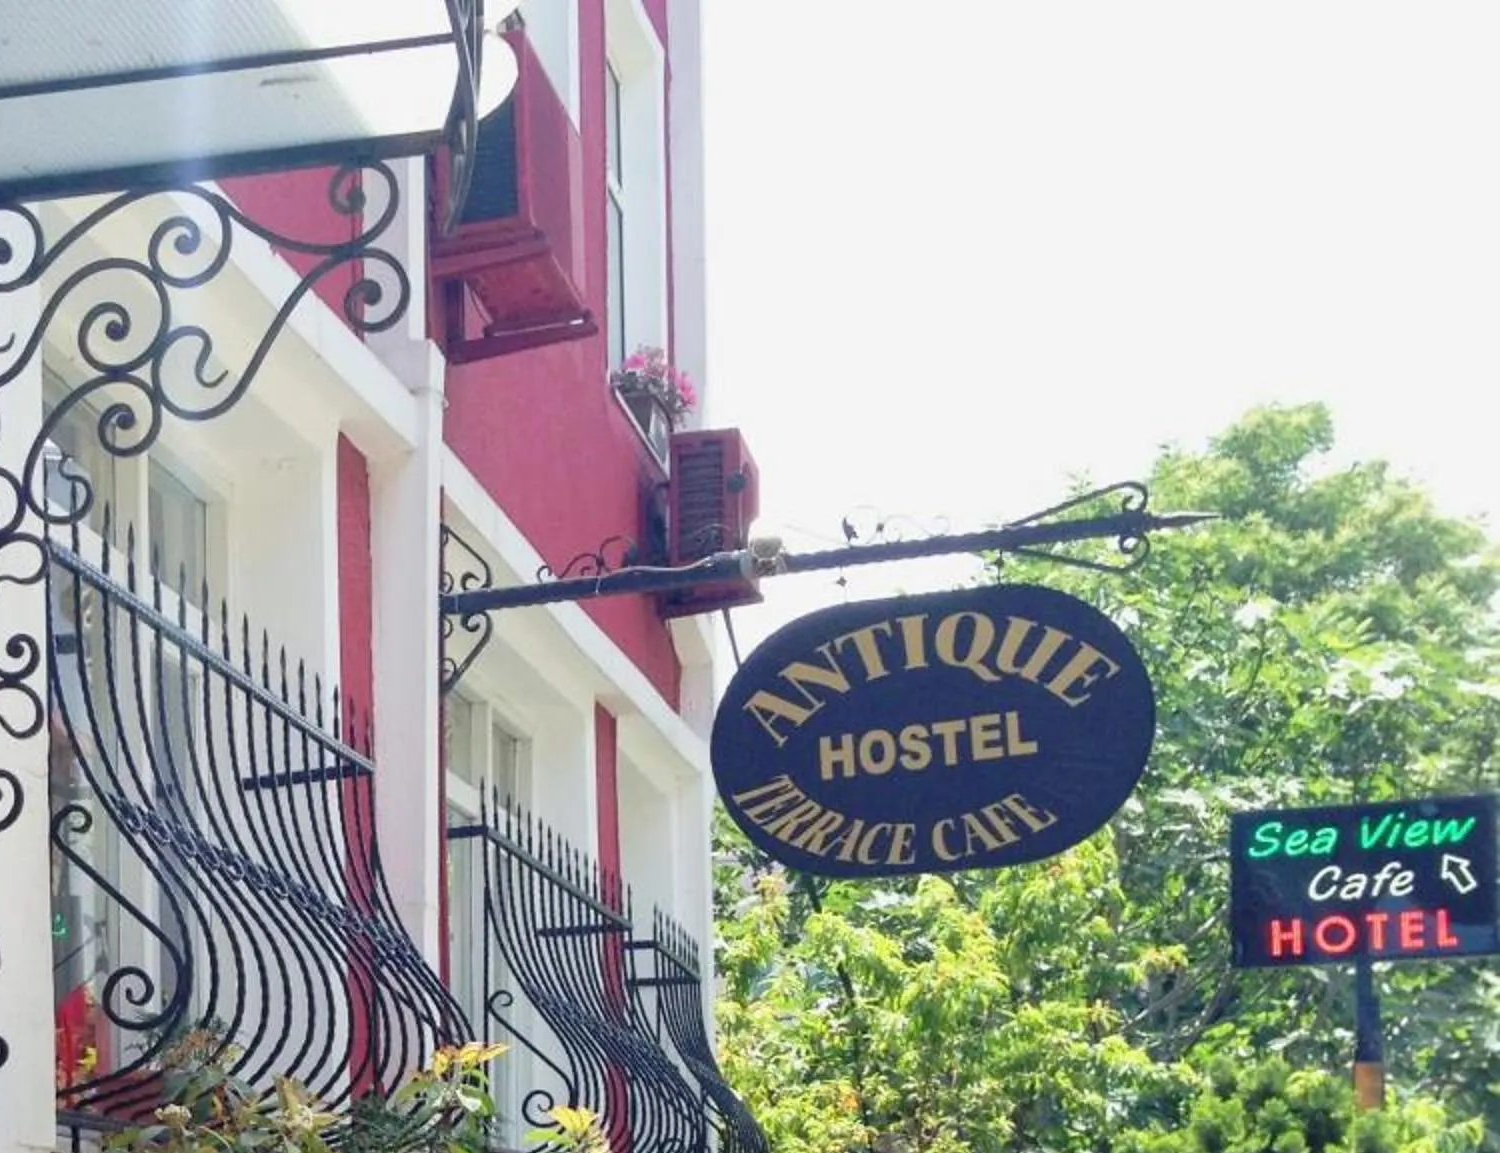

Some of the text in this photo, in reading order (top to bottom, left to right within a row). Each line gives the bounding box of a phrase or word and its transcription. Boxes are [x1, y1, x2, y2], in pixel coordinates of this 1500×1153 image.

[743, 611, 1121, 748] ANTIQUE
[819, 711, 1038, 781] HOSTEL
[733, 774, 1058, 865] TERRACE CAFE
[1249, 812, 1476, 858] Sea View
[1308, 861, 1415, 901] Cafe
[1270, 908, 1459, 957] HOTEL
